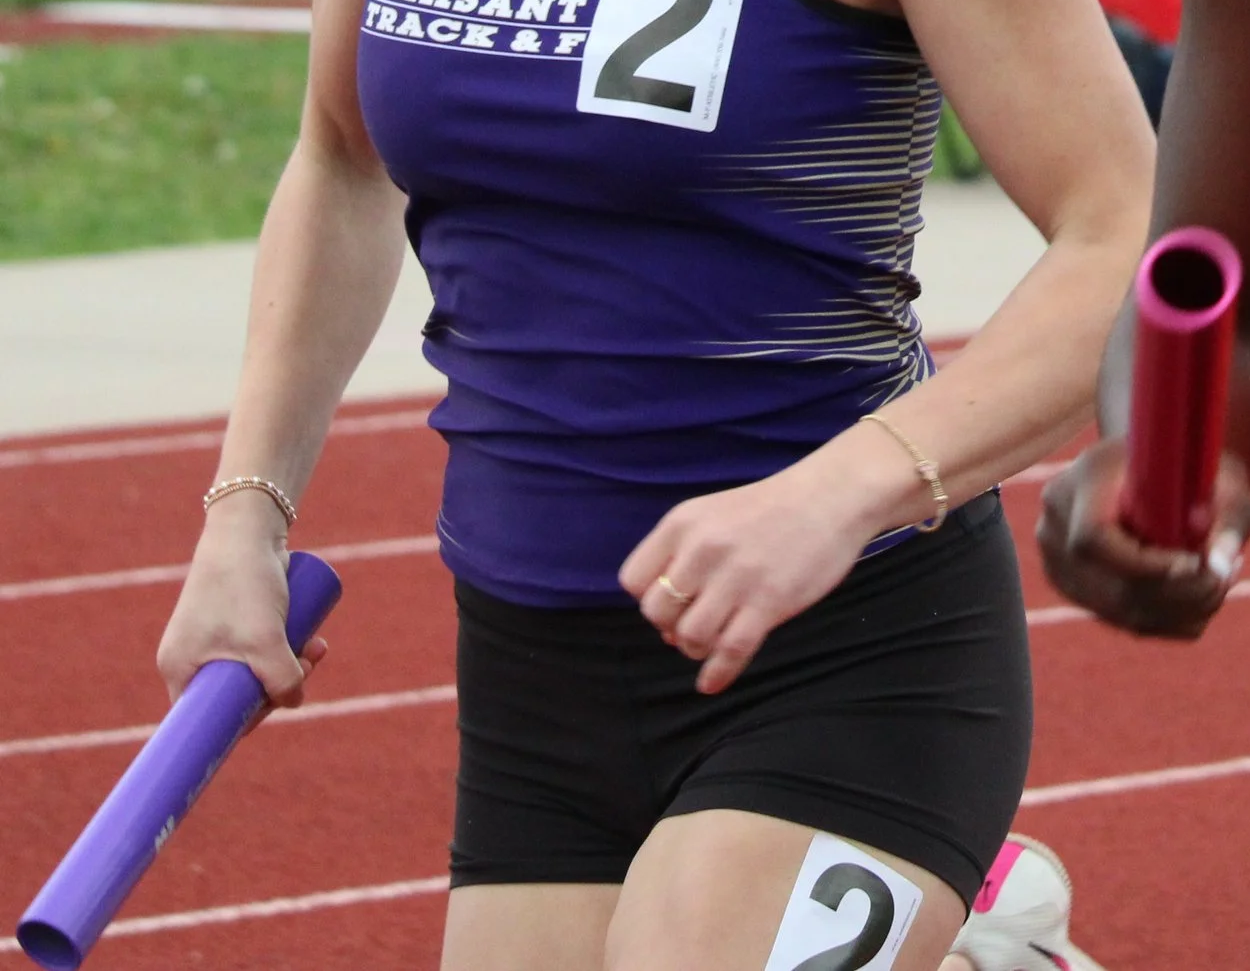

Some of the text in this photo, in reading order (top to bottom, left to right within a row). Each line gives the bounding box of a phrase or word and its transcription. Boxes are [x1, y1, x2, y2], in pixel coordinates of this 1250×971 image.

[365, 2, 499, 49] TRACK
[510, 29, 542, 54] &
[791, 862, 895, 971] 2
